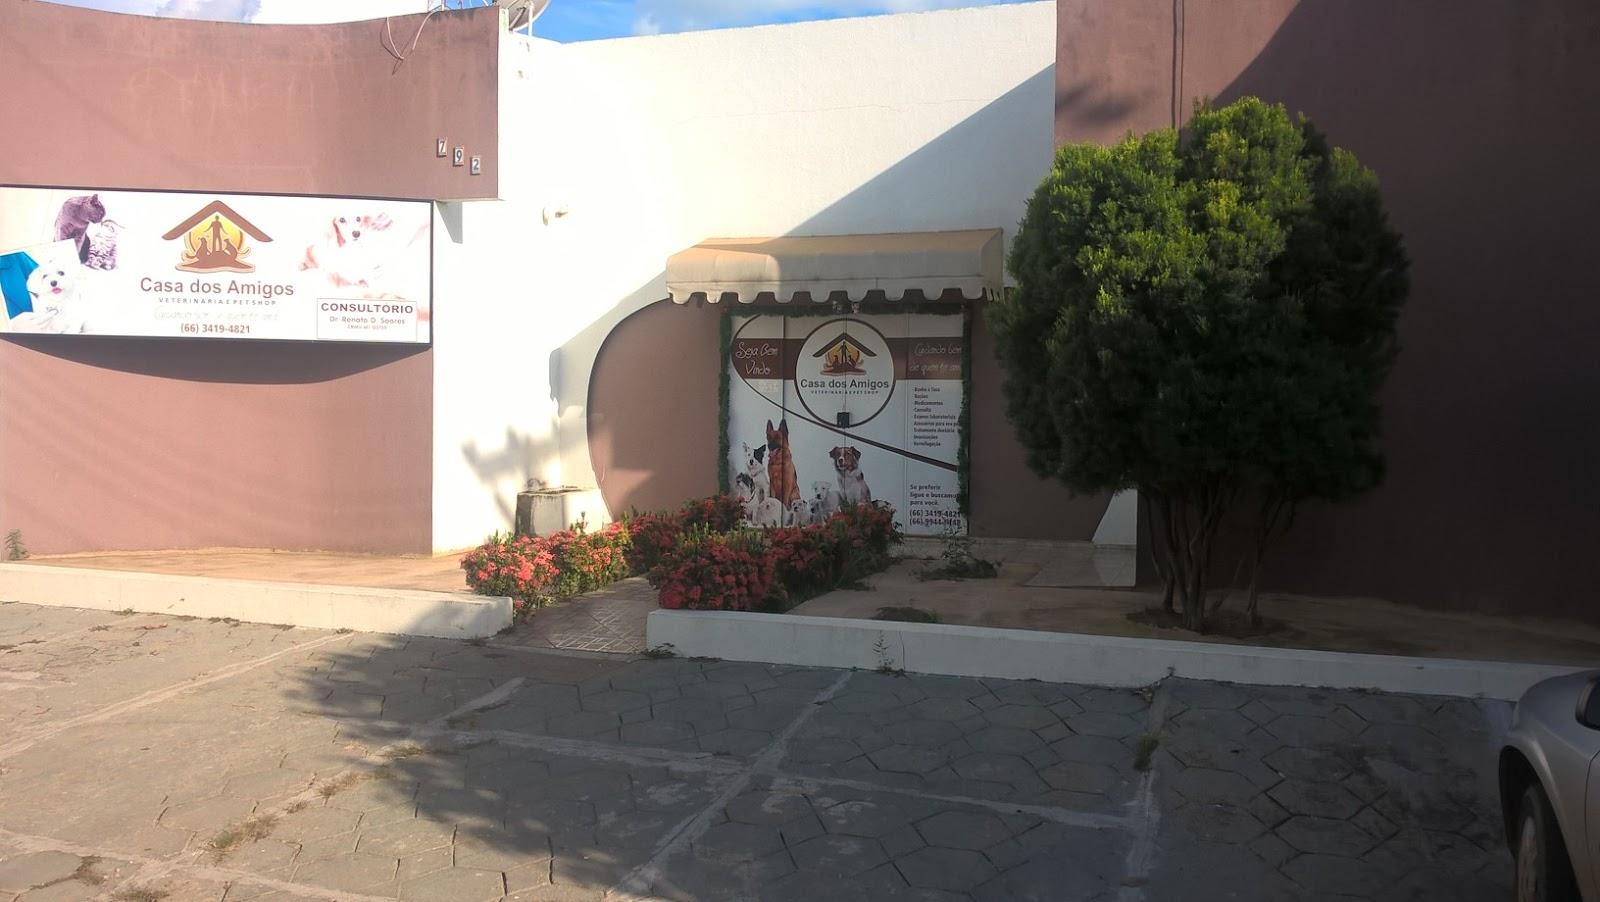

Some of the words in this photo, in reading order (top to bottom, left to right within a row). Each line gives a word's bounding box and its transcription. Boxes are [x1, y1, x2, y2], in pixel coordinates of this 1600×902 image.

[140, 276, 183, 292] Casa
[190, 279, 222, 294] dos
[227, 280, 294, 299] Amigos
[180, 323, 199, 334] (66)
[202, 324, 250, 334] 3419-4821
[800, 379, 826, 389] Casa
[828, 379, 847, 389] dos
[849, 379, 889, 391] Amigos
[909, 509, 923, 519] (66)
